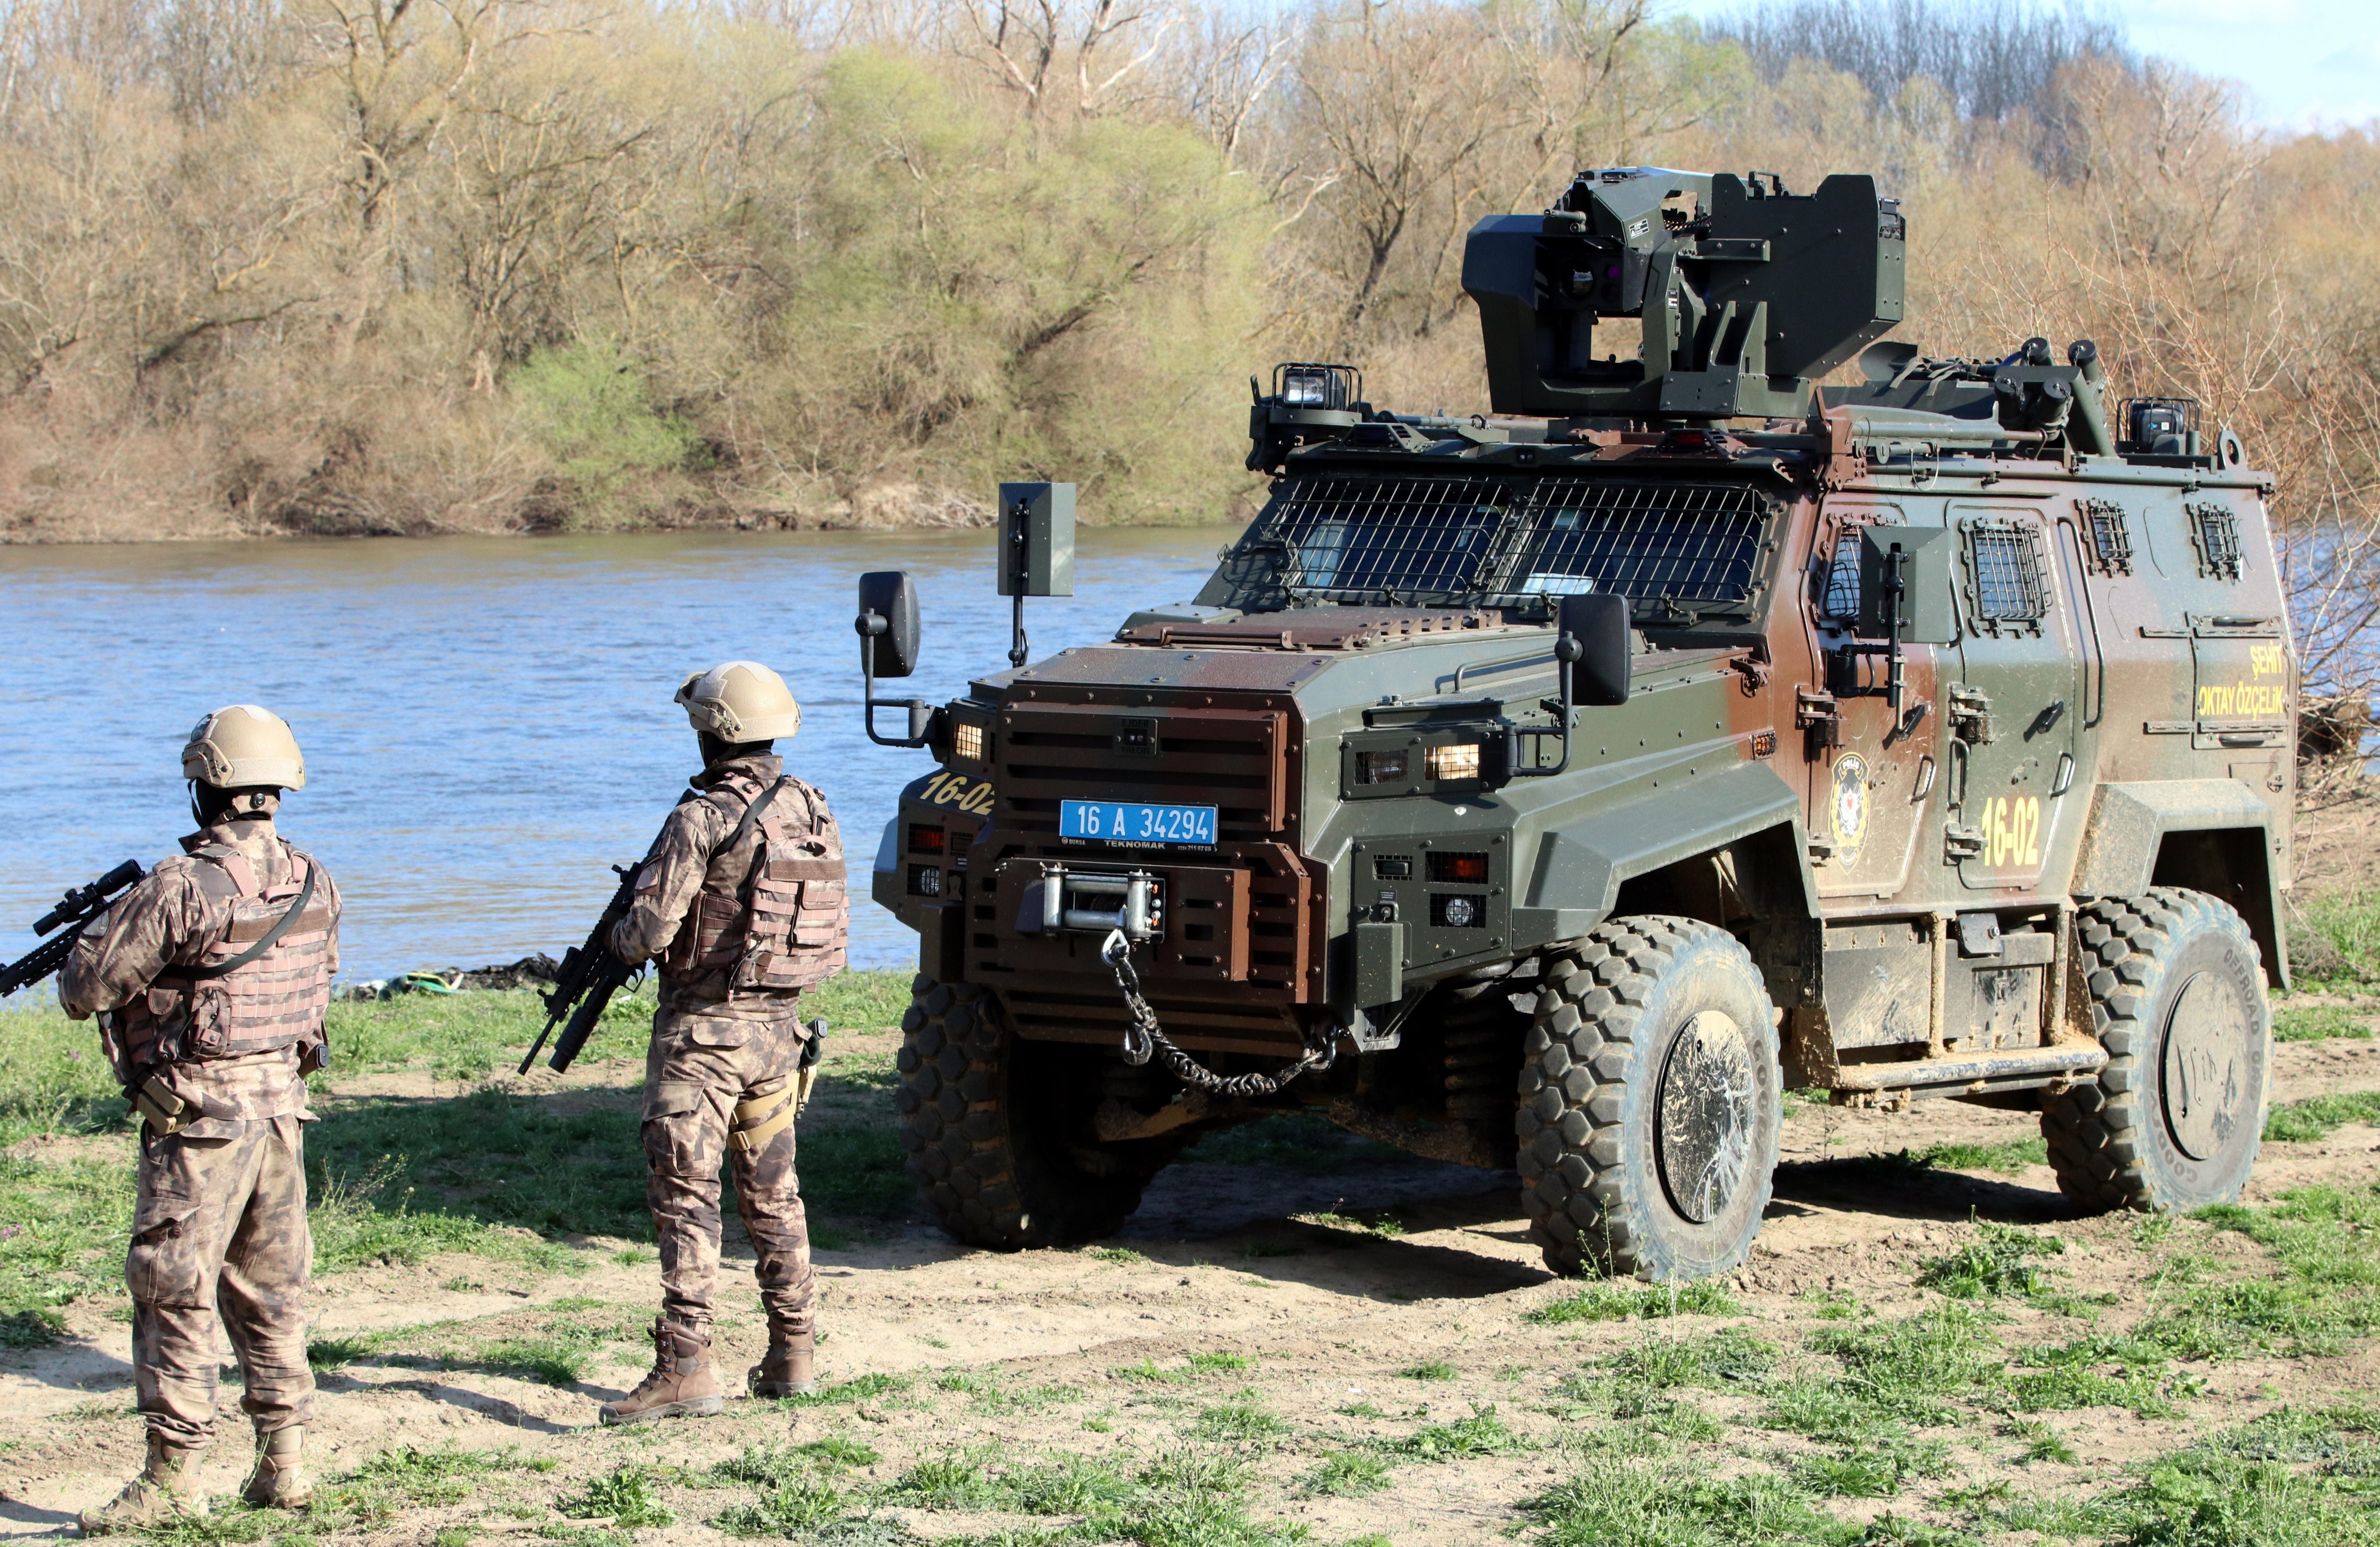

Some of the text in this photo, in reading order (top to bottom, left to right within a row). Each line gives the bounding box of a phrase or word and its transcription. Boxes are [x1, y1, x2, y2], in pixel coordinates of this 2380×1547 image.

[2250, 640, 2282, 681] ŞEHİT
[2199, 686, 2235, 716] OKTAY
[1122, 719, 1149, 728] EJDER
[1078, 805, 1208, 840] 16 A 34294
[1982, 797, 2039, 867] 16-02
[1104, 840, 1165, 849] TEKNOMAK
[2224, 949, 2259, 1035] OFFROAD
